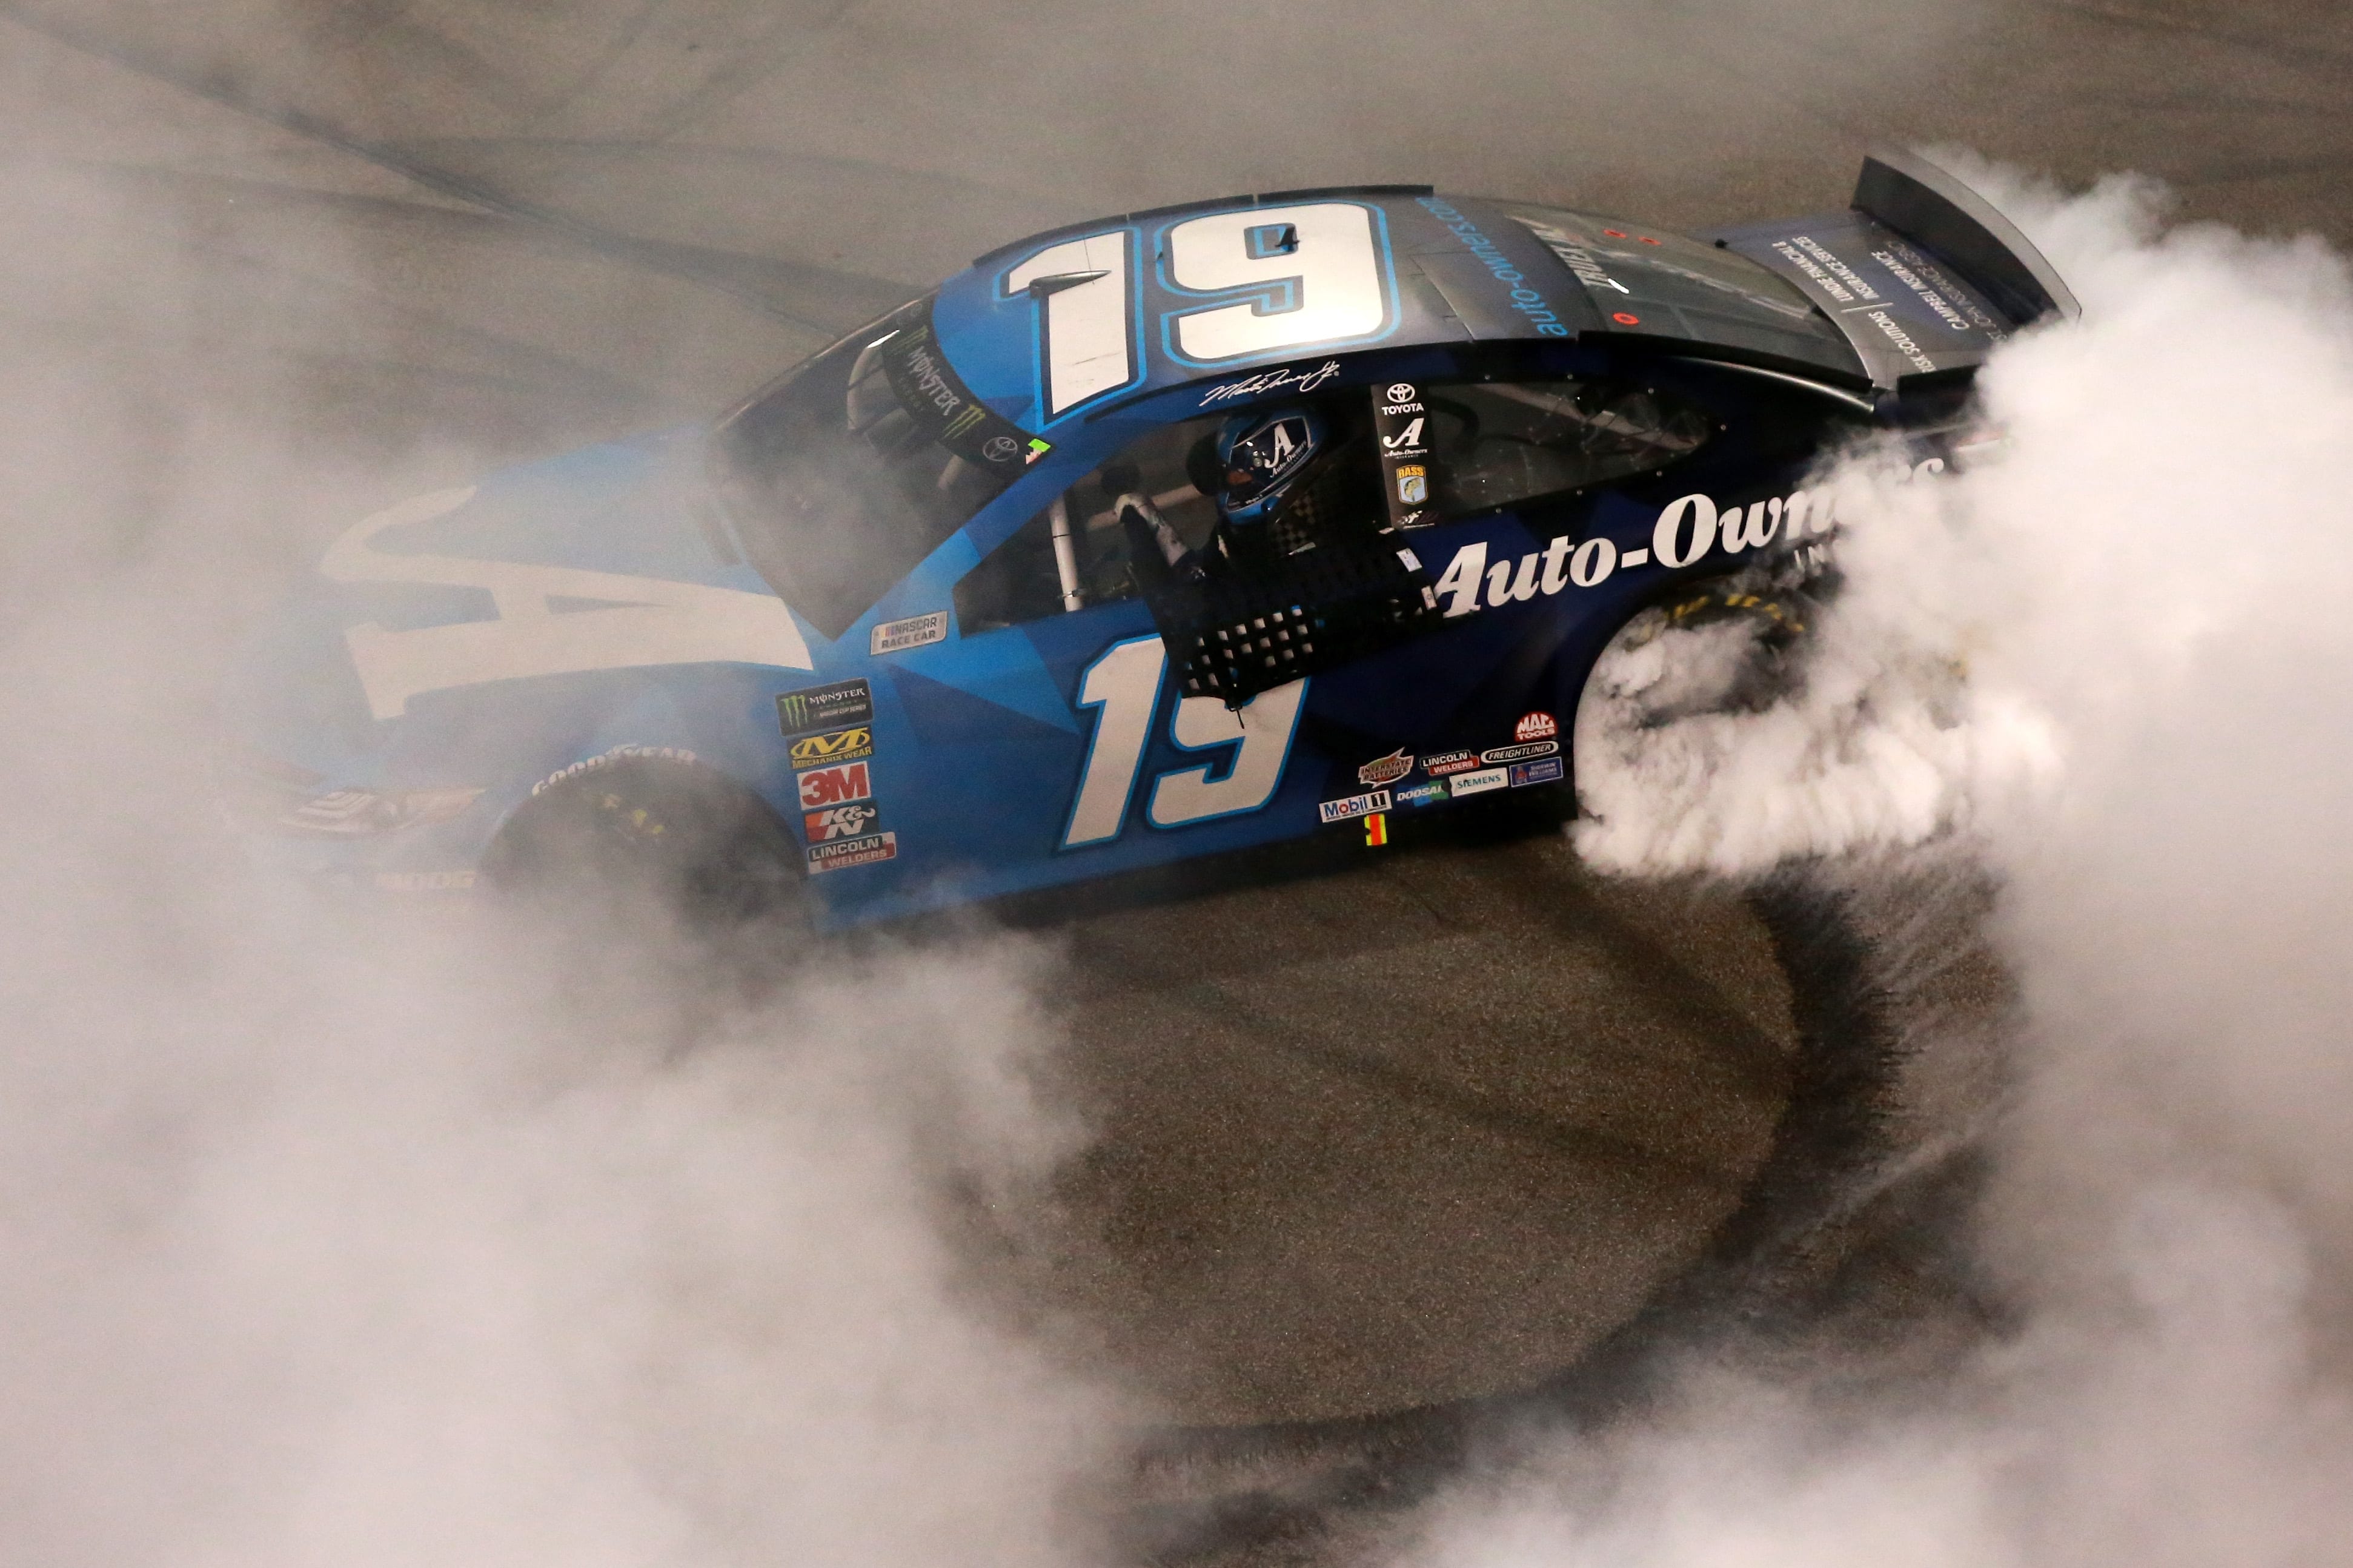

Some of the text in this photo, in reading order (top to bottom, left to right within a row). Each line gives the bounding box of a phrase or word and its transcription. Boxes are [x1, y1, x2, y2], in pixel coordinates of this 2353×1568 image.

[997, 201, 1396, 431] 19
[1381, 402, 1424, 416] TOYOTA
[1383, 418, 1424, 448] A
[1264, 422, 1295, 469] A
[1384, 448, 1428, 457] Auto-Owners
[1433, 457, 1945, 619] Auto-Own
[896, 617, 937, 635] NASCAR
[881, 630, 936, 649] RACE CAR
[809, 688, 865, 704] MONSTER
[1517, 714, 1555, 733] MAC
[1061, 634, 1312, 848] 19
[1517, 727, 1555, 740] TOOLS
[792, 746, 872, 769] MECHANIX WEAR
[1423, 752, 1468, 767] LINCOLN
[1488, 744, 1552, 760] FREIGHTLINER
[1362, 759, 1411, 773] INTERSTATE
[1364, 766, 1409, 780] BATTERIES
[1433, 760, 1473, 773] WELDERS
[802, 764, 868, 806] 3M
[1457, 775, 1501, 789] SIEMENS
[1324, 796, 1367, 816] Mobil
[1371, 792, 1386, 807] 1
[812, 837, 878, 859] LINCOLN
[828, 849, 887, 867] WELDERS
